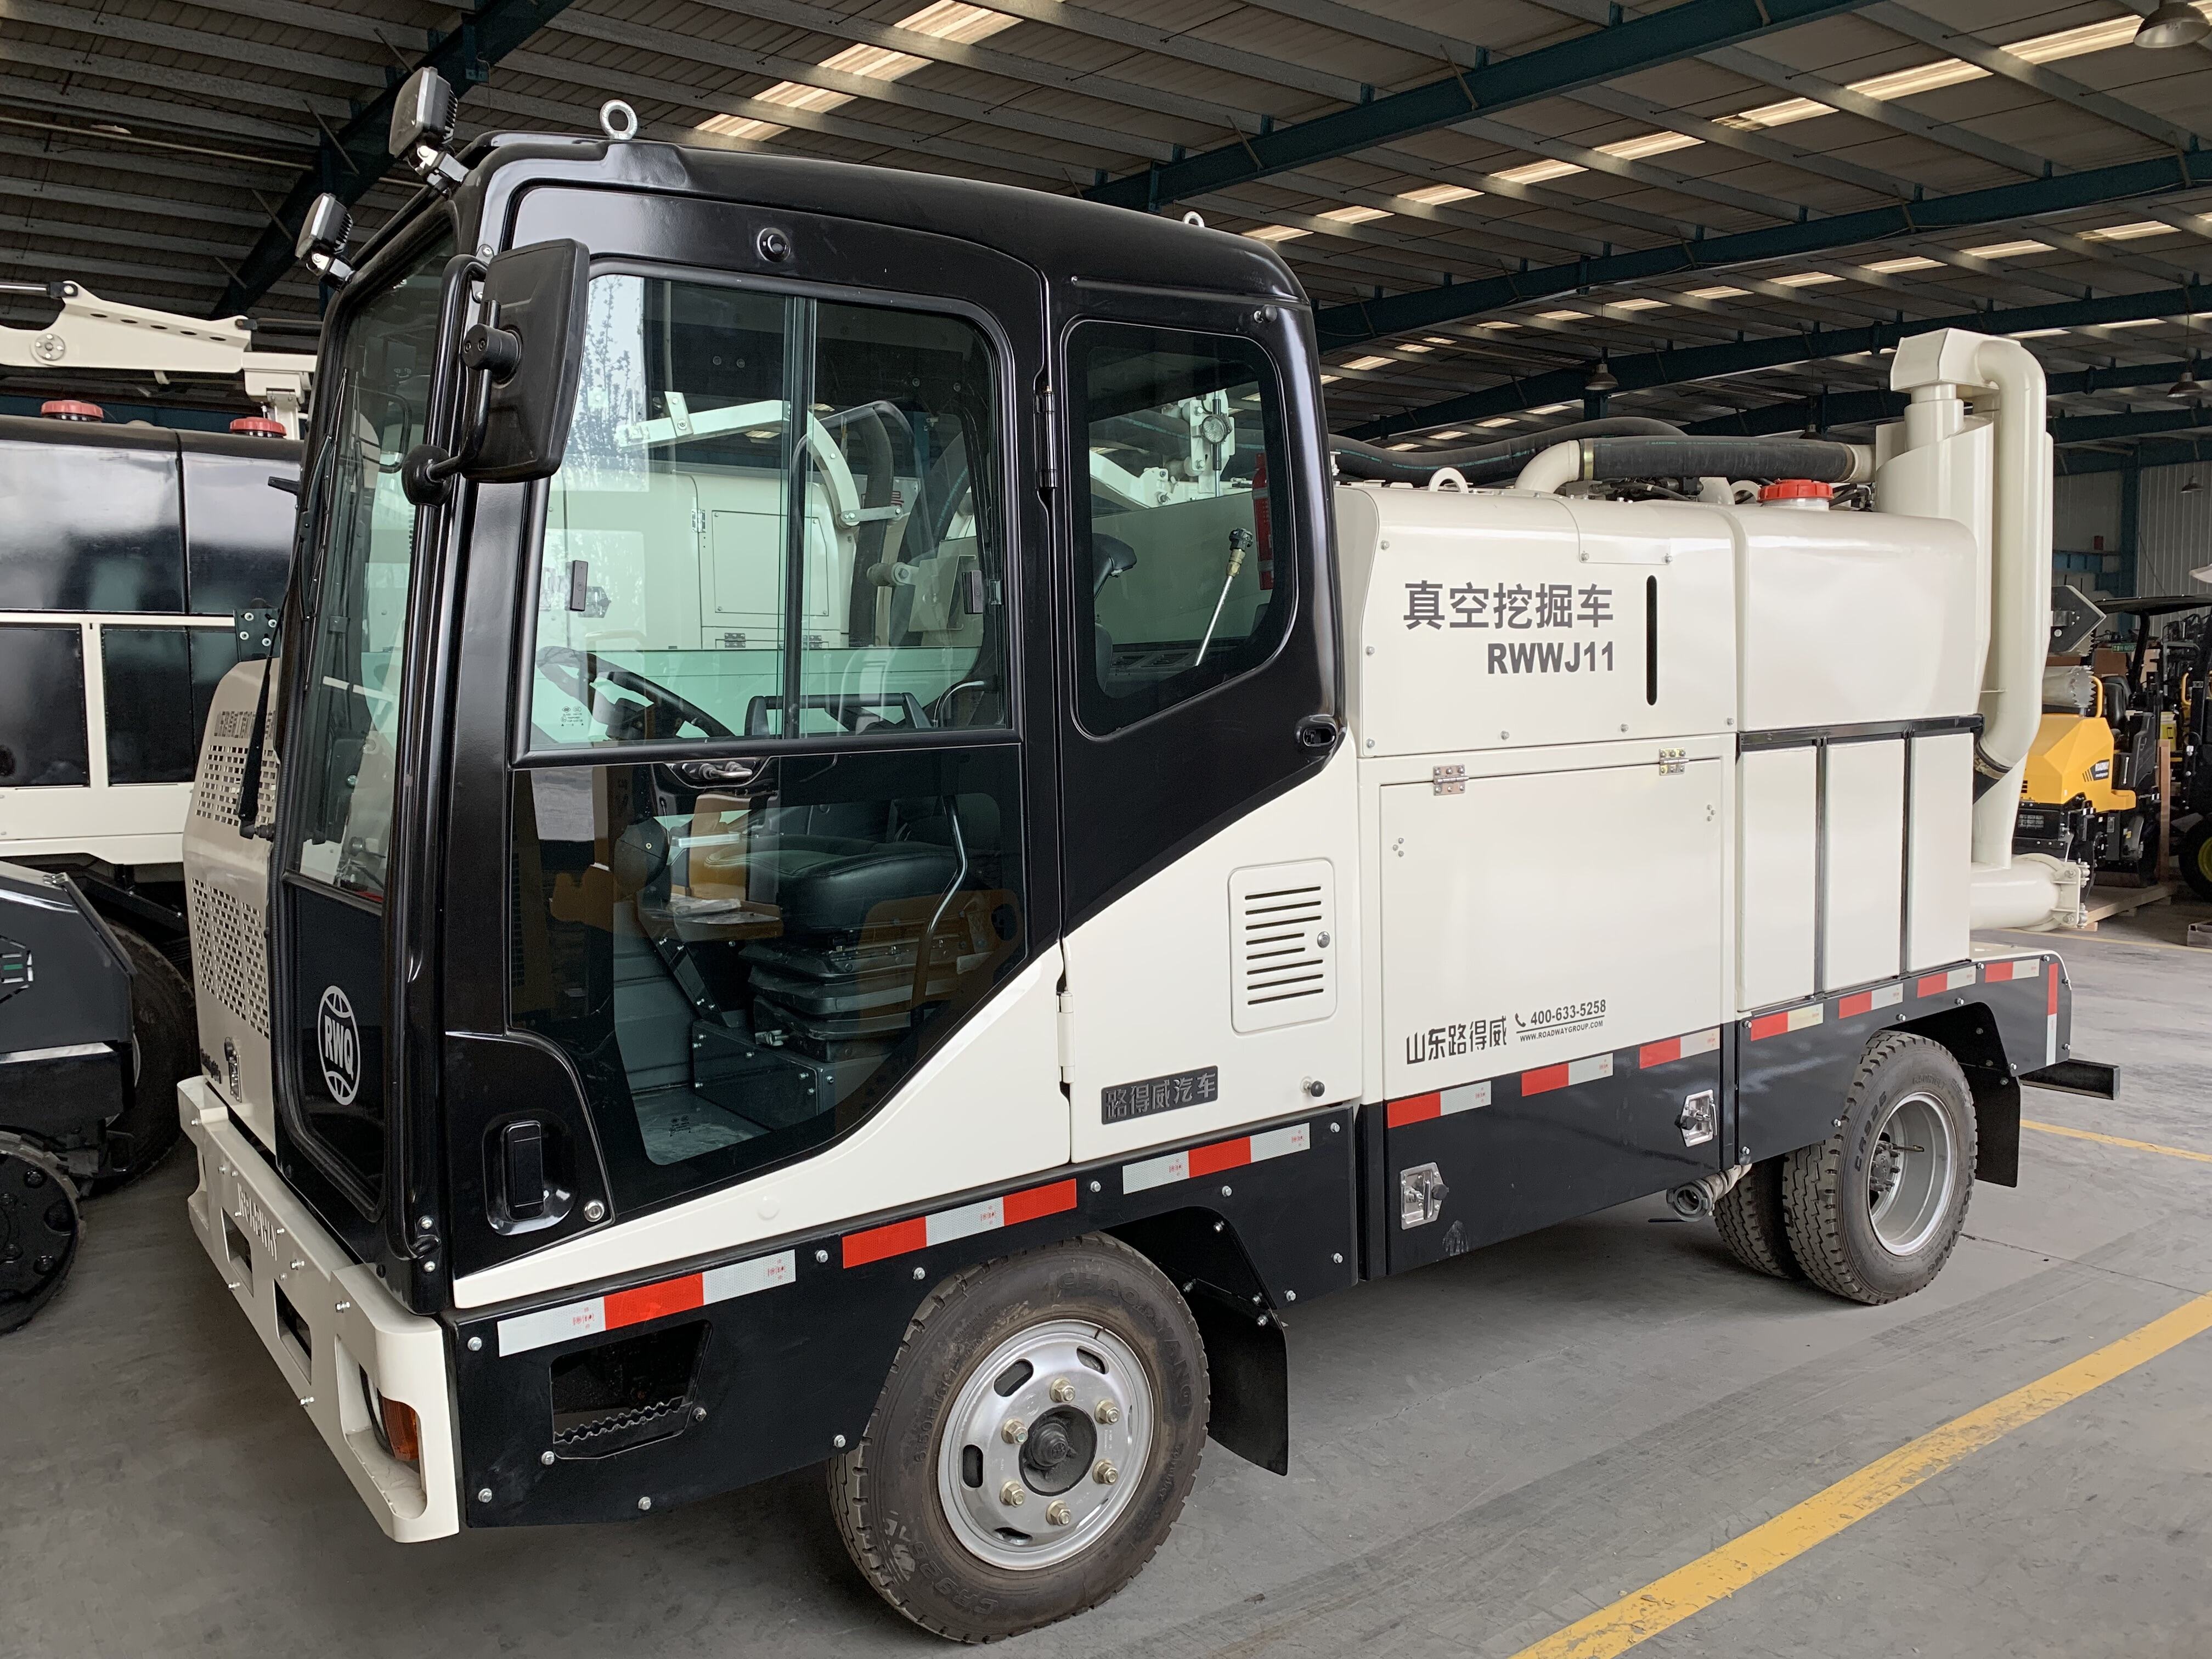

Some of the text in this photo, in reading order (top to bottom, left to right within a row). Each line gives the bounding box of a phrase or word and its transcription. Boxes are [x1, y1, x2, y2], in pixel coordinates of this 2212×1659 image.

[1403, 579, 1614, 630] 真空挖掘车
[1487, 641, 1613, 674] RWWJ11
[1520, 1020, 1603, 1042] WWW.ROADWAYGROUP.COM
[1531, 999, 1606, 1025] 400-633-5258
[1406, 1015, 1506, 1064] 山东路得威
[1106, 1073, 1216, 1120] 路得威汽车
